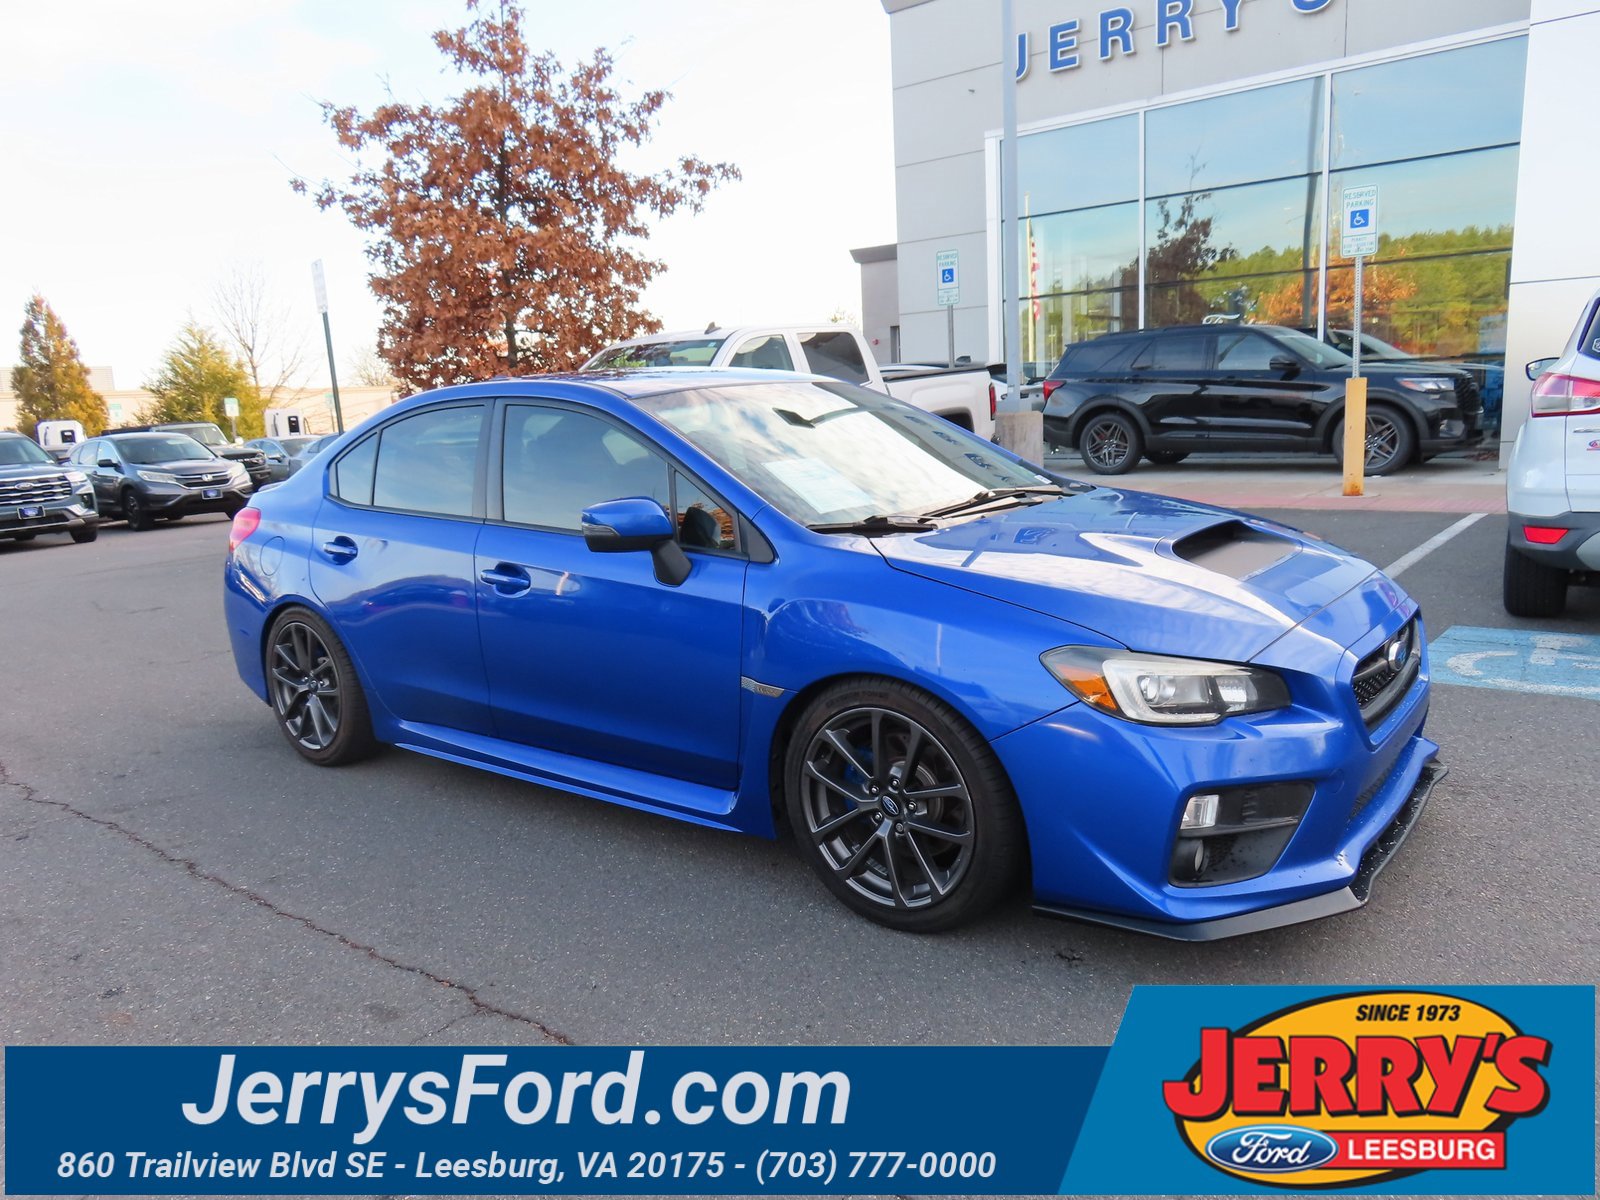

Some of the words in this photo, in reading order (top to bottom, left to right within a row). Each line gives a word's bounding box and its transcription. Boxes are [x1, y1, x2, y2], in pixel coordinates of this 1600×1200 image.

[1015, 0, 1333, 82] JERRY
[1344, 190, 1376, 200] RESERVED
[1346, 199, 1374, 208] PARKING
